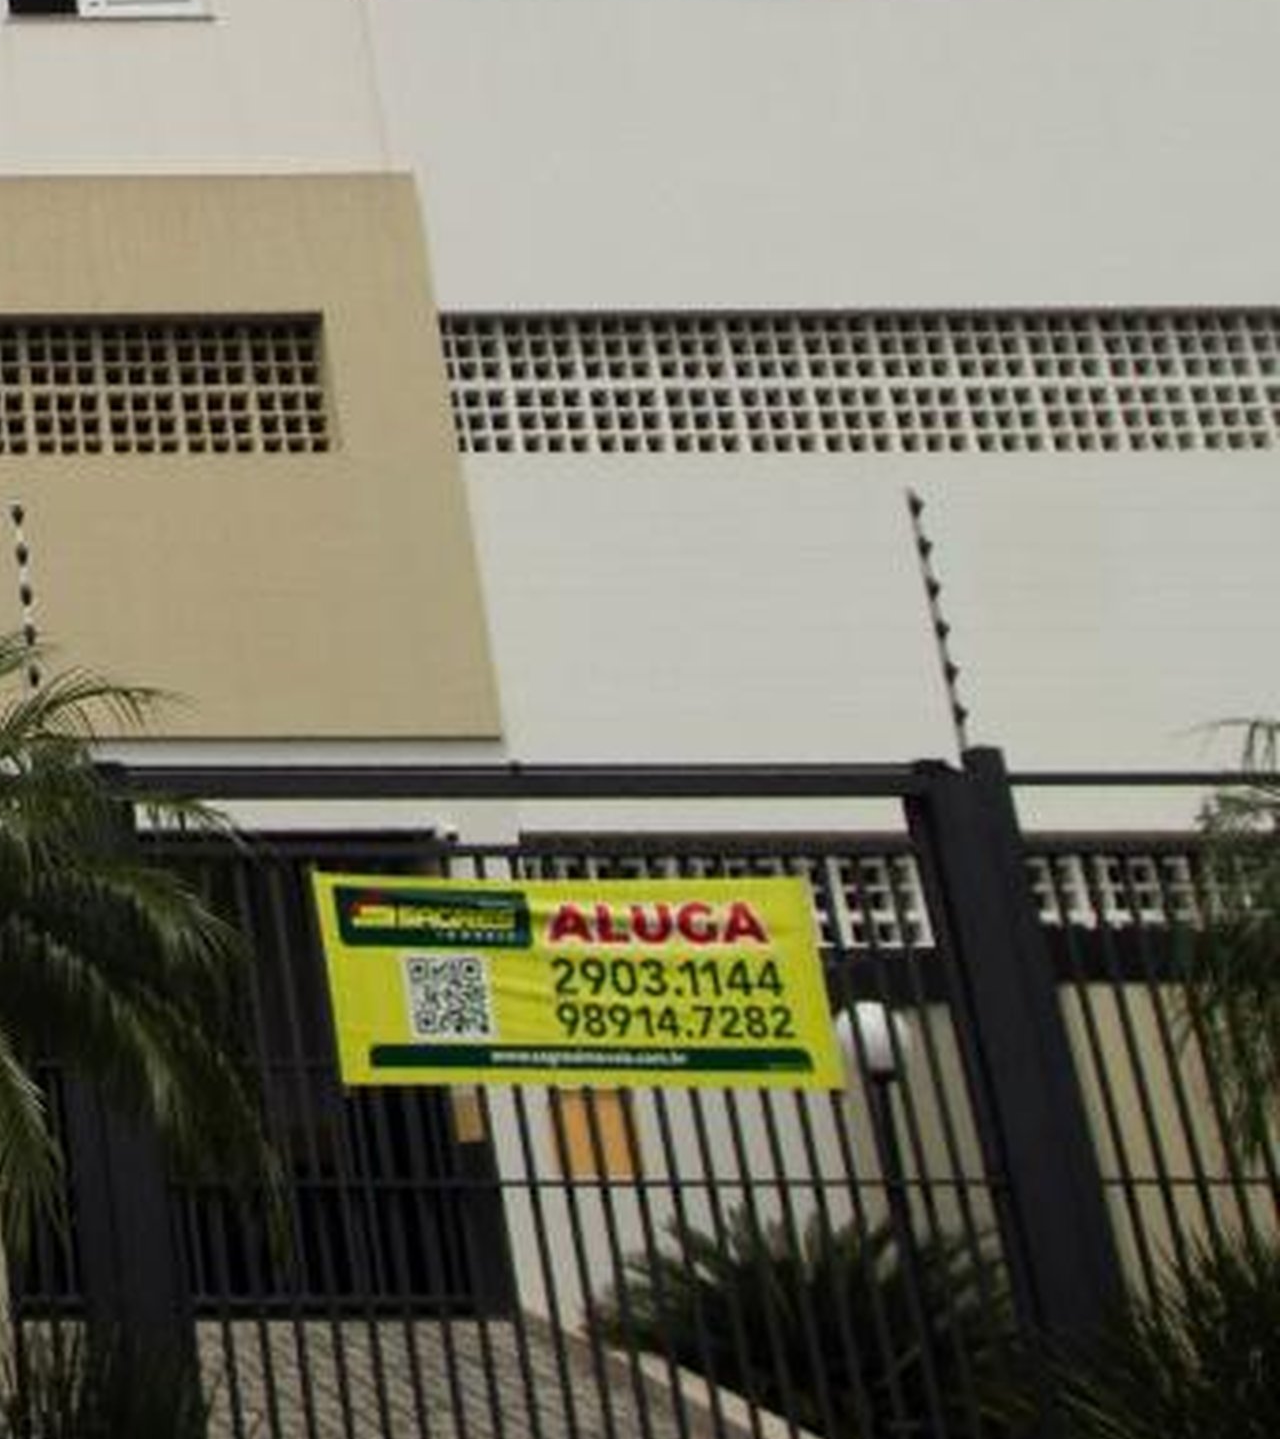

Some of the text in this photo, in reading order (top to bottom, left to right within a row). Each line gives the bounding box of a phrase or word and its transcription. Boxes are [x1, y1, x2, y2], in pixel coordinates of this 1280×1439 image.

[548, 901, 769, 944] ALUGA
[551, 957, 785, 997] 2903.1144
[556, 1002, 796, 1039] 98914.7282
